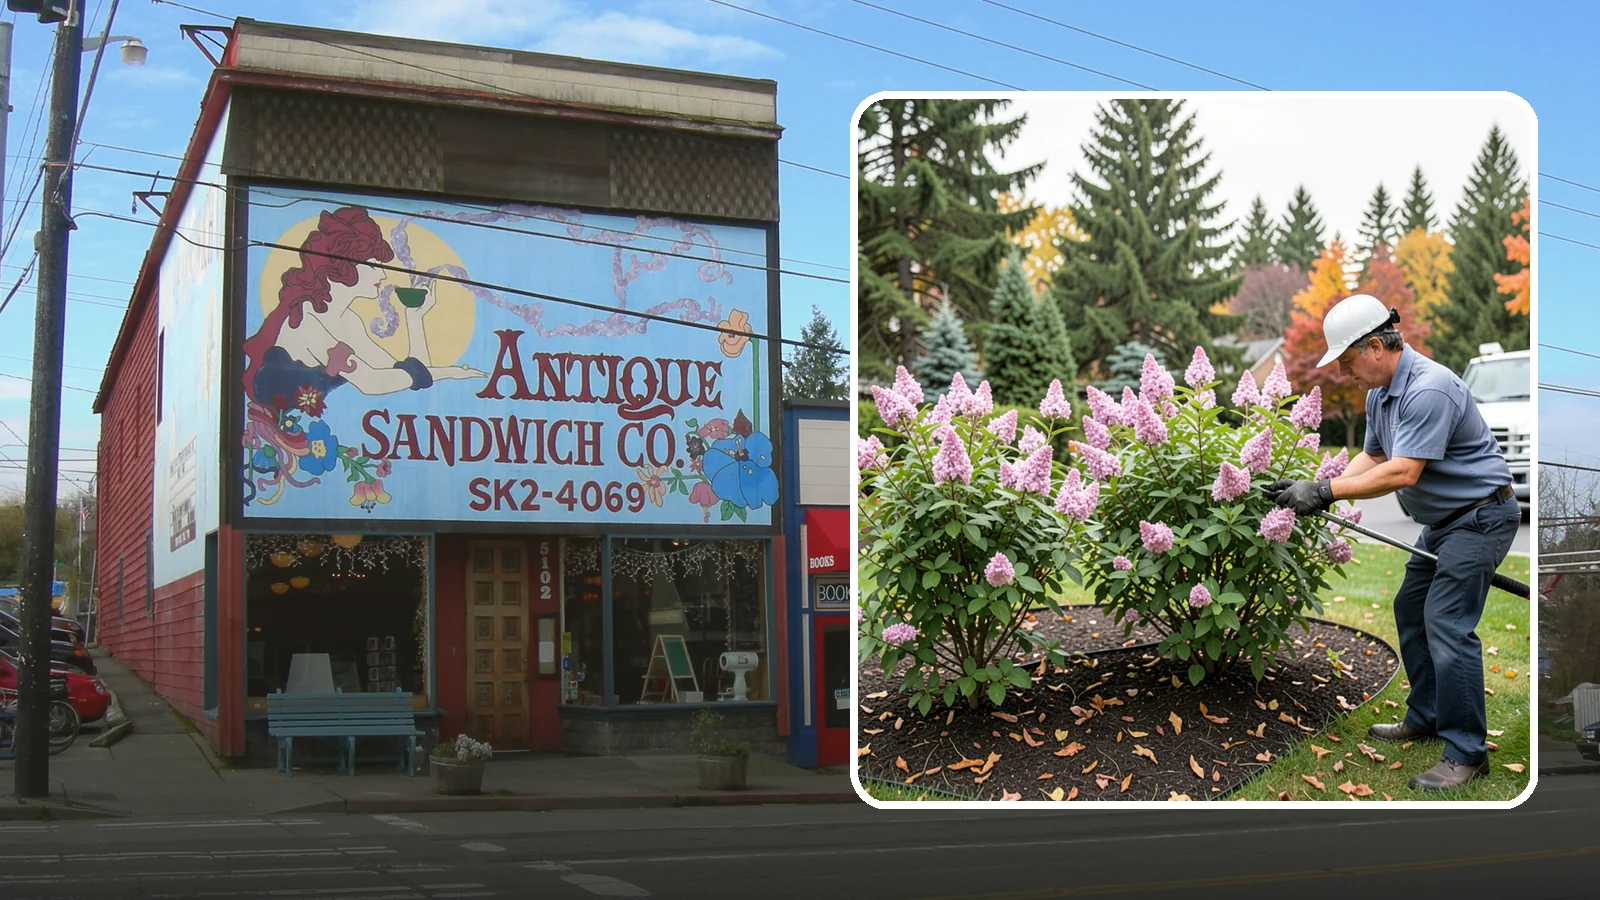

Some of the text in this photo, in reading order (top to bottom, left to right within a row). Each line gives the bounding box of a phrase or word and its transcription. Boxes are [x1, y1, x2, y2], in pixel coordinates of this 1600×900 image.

[476, 329, 723, 420] ANTIQUE
[361, 408, 685, 469] SANDWICH CO.
[469, 477, 645, 513] SK2-4069
[539, 541, 552, 600] 5102
[809, 555, 835, 569] BOOKS
